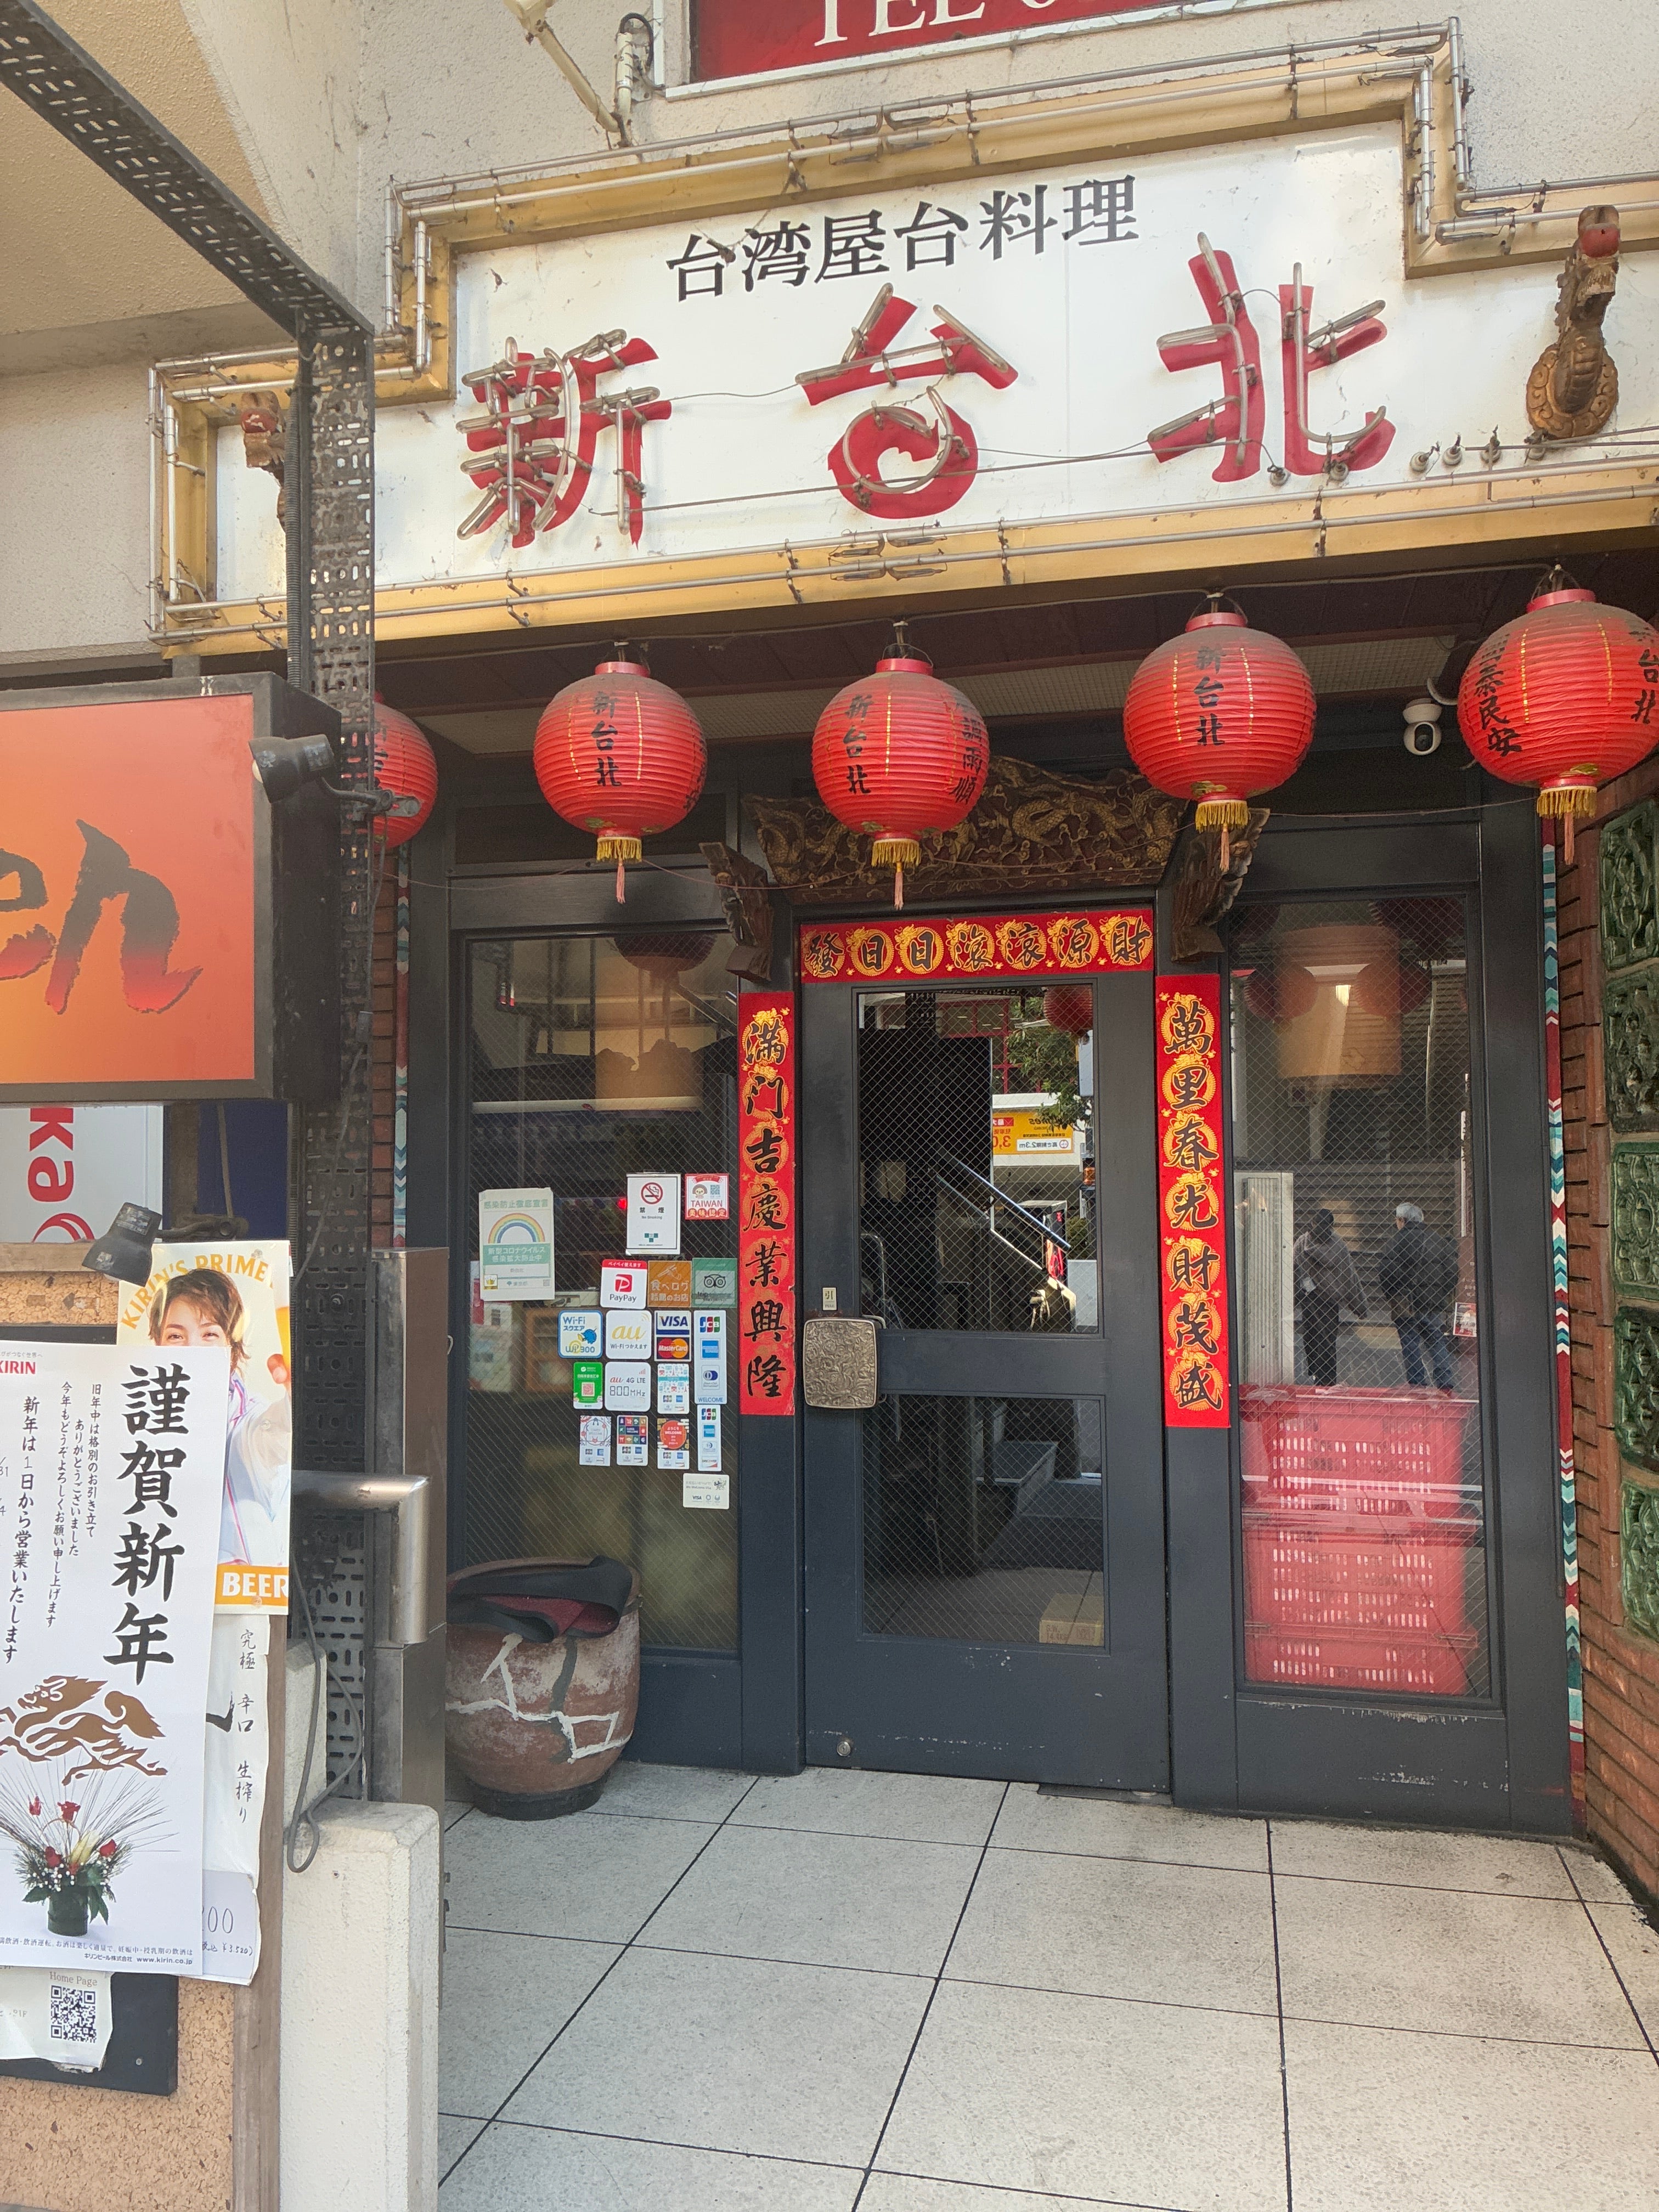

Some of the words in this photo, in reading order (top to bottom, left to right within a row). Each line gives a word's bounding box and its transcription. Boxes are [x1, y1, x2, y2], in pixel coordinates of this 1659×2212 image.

[814, 0, 985, 47] TEL
[666, 174, 1140, 302] 台湾屋台料理
[455, 236, 1396, 549] 新台北
[1193, 646, 1228, 746] 新台北
[590, 691, 622, 787] 新台北
[844, 695, 875, 795] 新台北
[1164, 1001, 1223, 1412] 萬里春光財茂盛
[488, 1246, 545, 1254] 新型コロナウイルス
[610, 1294, 637, 1303] PayPay
[651, 1279, 689, 1290] 食べログ
[563, 1316, 585, 1325] Wi-Fi
[612, 1325, 646, 1341] au
[660, 1316, 689, 1327] VISA
[86, 1383, 102, 1538] 旧年中は格別のお引き立て
[46, 1381, 73, 1628] 今年もどうぞよろしくお願い申し上げます
[69, 1418, 84, 1557] ありがとうございました
[103, 1363, 191, 1686] 謹賀新年
[221, 1572, 289, 1599] BEER
[240, 1629, 256, 1670] 究極
[238, 1693, 254, 1733] 辛口
[235, 1759, 253, 1824] 生搾り
[49, 1971, 74, 1983] Home
[76, 1976, 98, 1988] Page
[84, 1953, 132, 1962] キリンビール株式会社
[136, 1956, 193, 1965] www.kirin.co.jp
